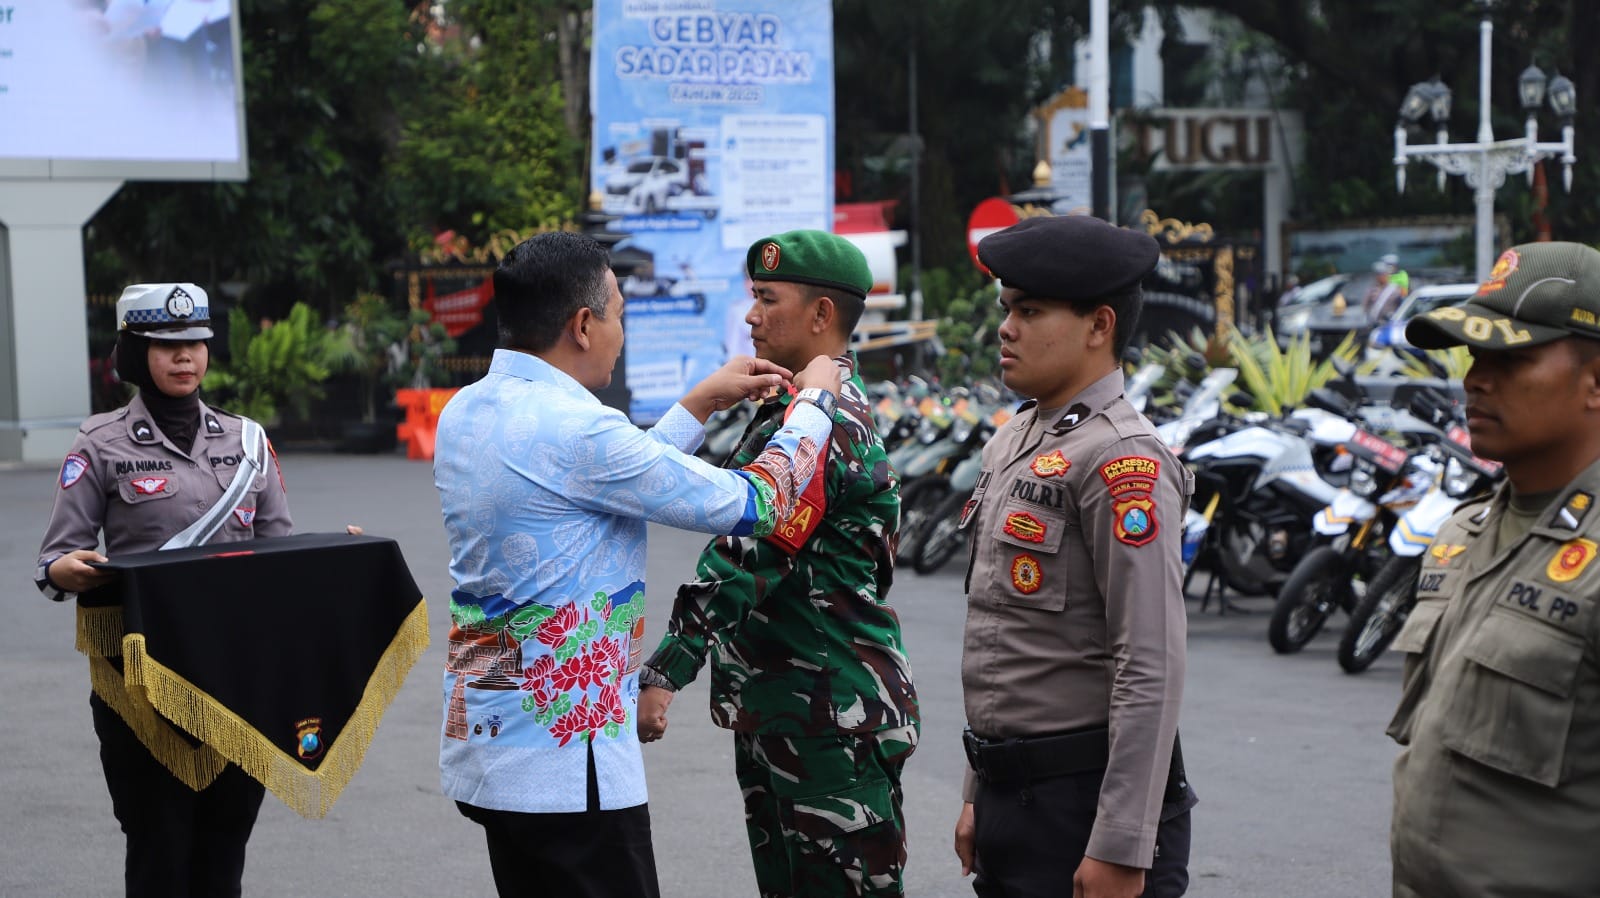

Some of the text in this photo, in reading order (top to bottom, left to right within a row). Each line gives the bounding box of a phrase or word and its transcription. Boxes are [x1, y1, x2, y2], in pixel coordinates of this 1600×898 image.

[653, 15, 778, 46] GEBYAR
[619, 50, 808, 79] SADAR PAJAK
[1429, 306, 1532, 345] POL
[137, 460, 172, 474] NIMAS
[1103, 458, 1156, 475] POLRESTA
[1137, 466, 1155, 475] KOTA
[1010, 478, 1065, 509] POLRI
[1506, 581, 1579, 623] POL PP
